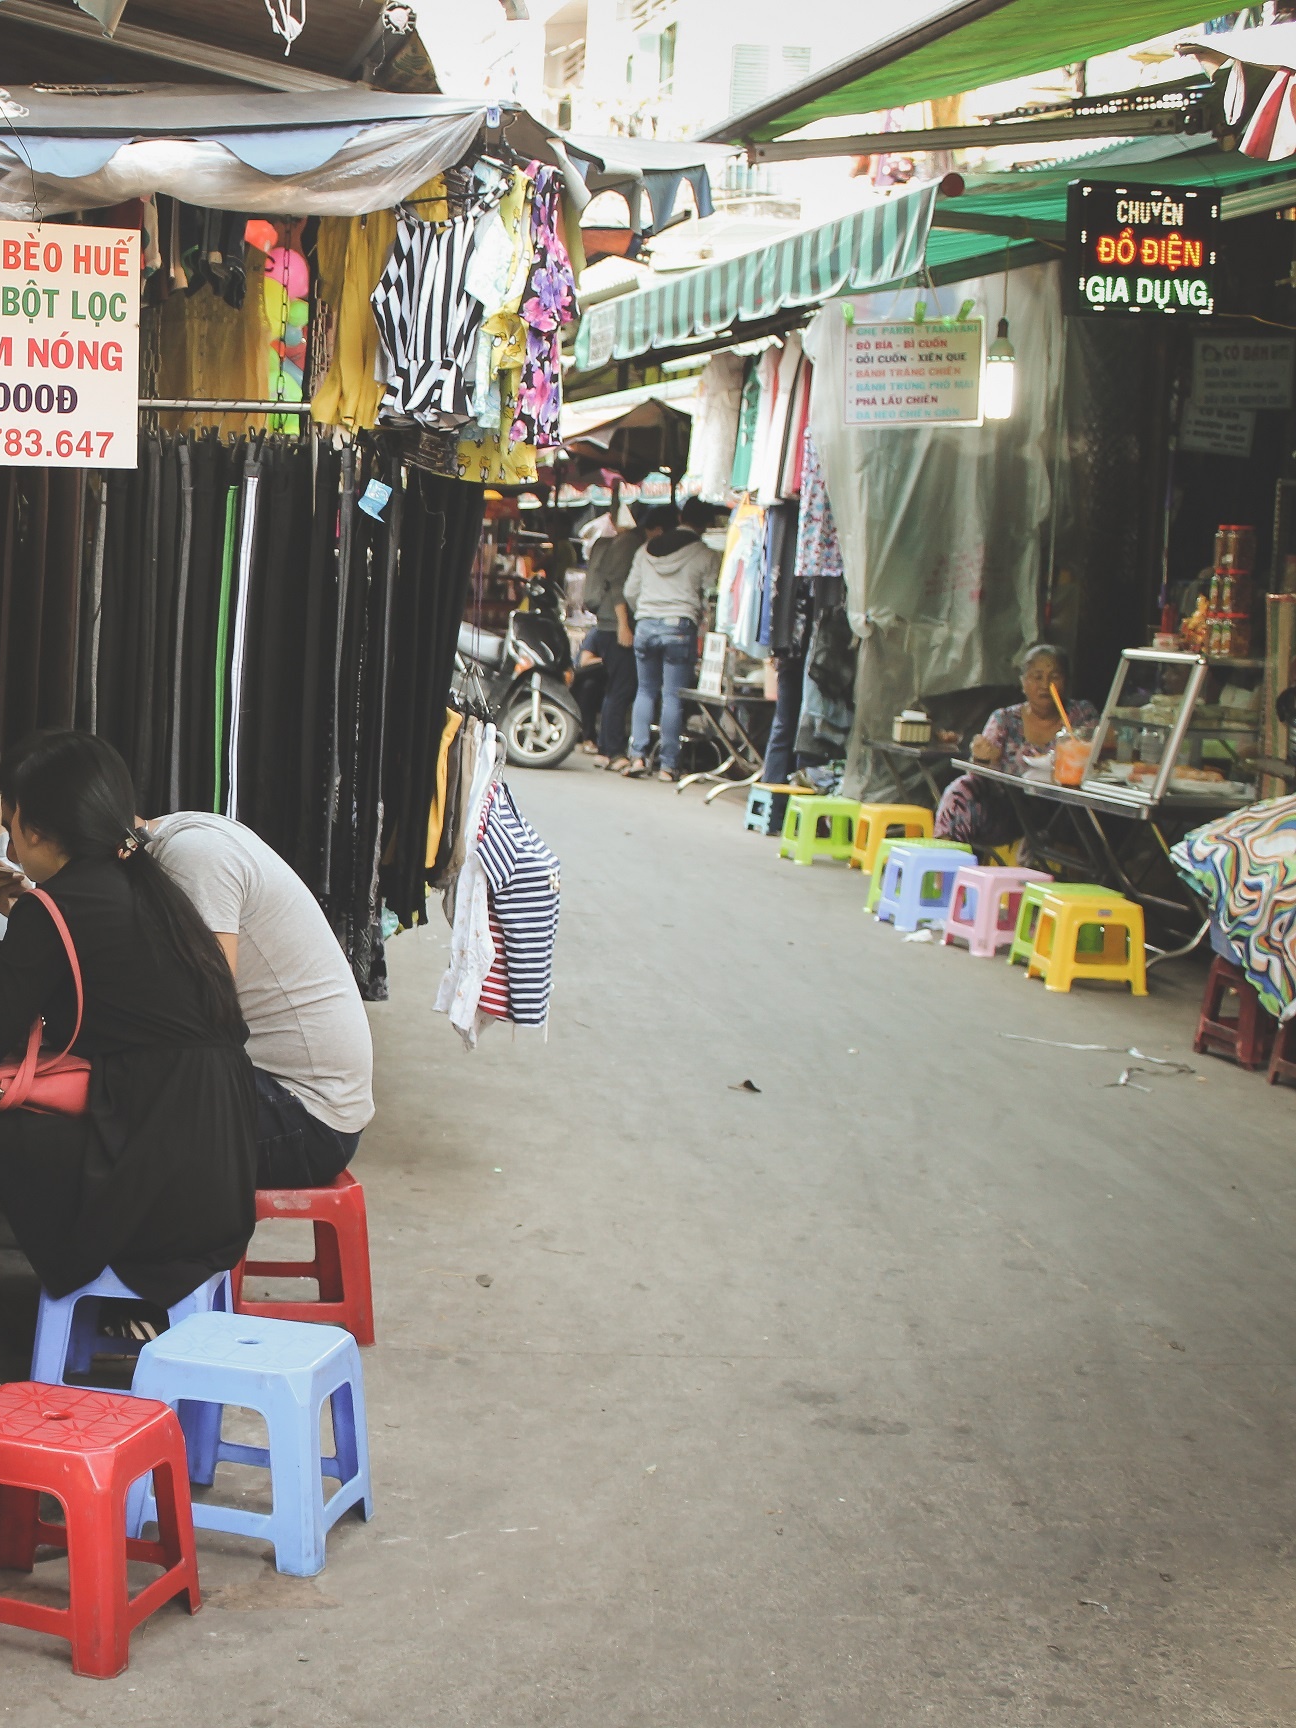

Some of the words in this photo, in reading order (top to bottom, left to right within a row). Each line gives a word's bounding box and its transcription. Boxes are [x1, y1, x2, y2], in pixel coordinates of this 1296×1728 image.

[3, 232, 63, 273] BÈO
[73, 235, 135, 277] HUẾ
[1097, 227, 1136, 265] ĐỒ
[1140, 232, 1202, 271] ĐIỆN
[1, 279, 60, 323] BỘT
[71, 290, 128, 328] LỌC
[1086, 276, 1129, 303] GIA
[27, 330, 123, 372] NÓNG
